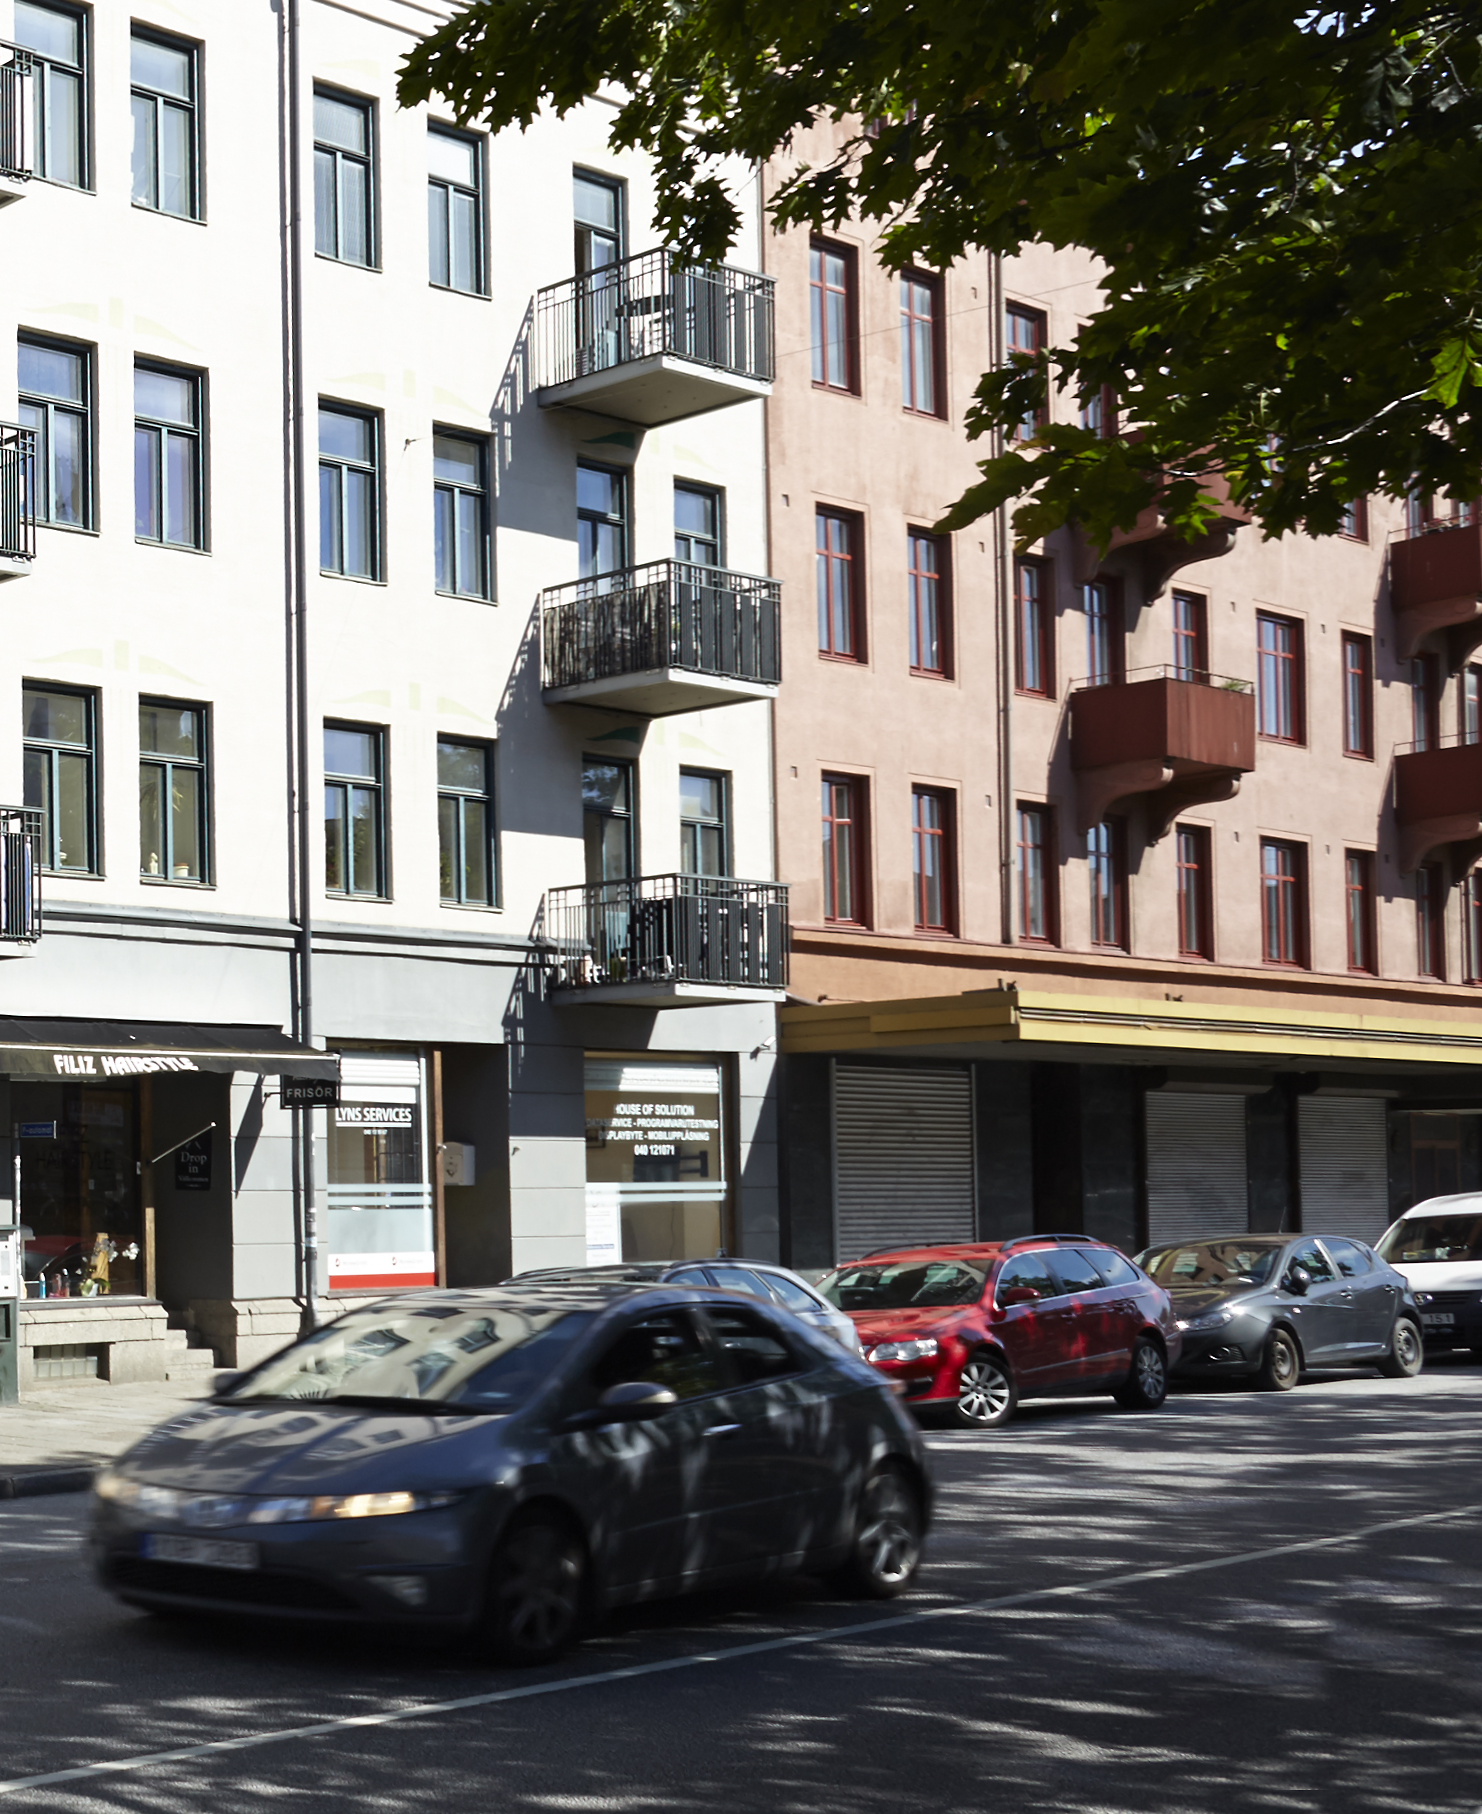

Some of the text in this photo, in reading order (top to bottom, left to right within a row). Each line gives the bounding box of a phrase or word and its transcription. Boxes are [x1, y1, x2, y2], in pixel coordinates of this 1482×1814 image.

[53, 1054, 199, 1076] FILIZ HAIRSTYLE
[286, 1086, 333, 1098] FRISÖR
[335, 1107, 412, 1122] LYNS SERVICES
[614, 1103, 695, 1116] HOUSE OF SOLUTION
[181, 1151, 207, 1165] Drop
[188, 1163, 199, 1173] in
